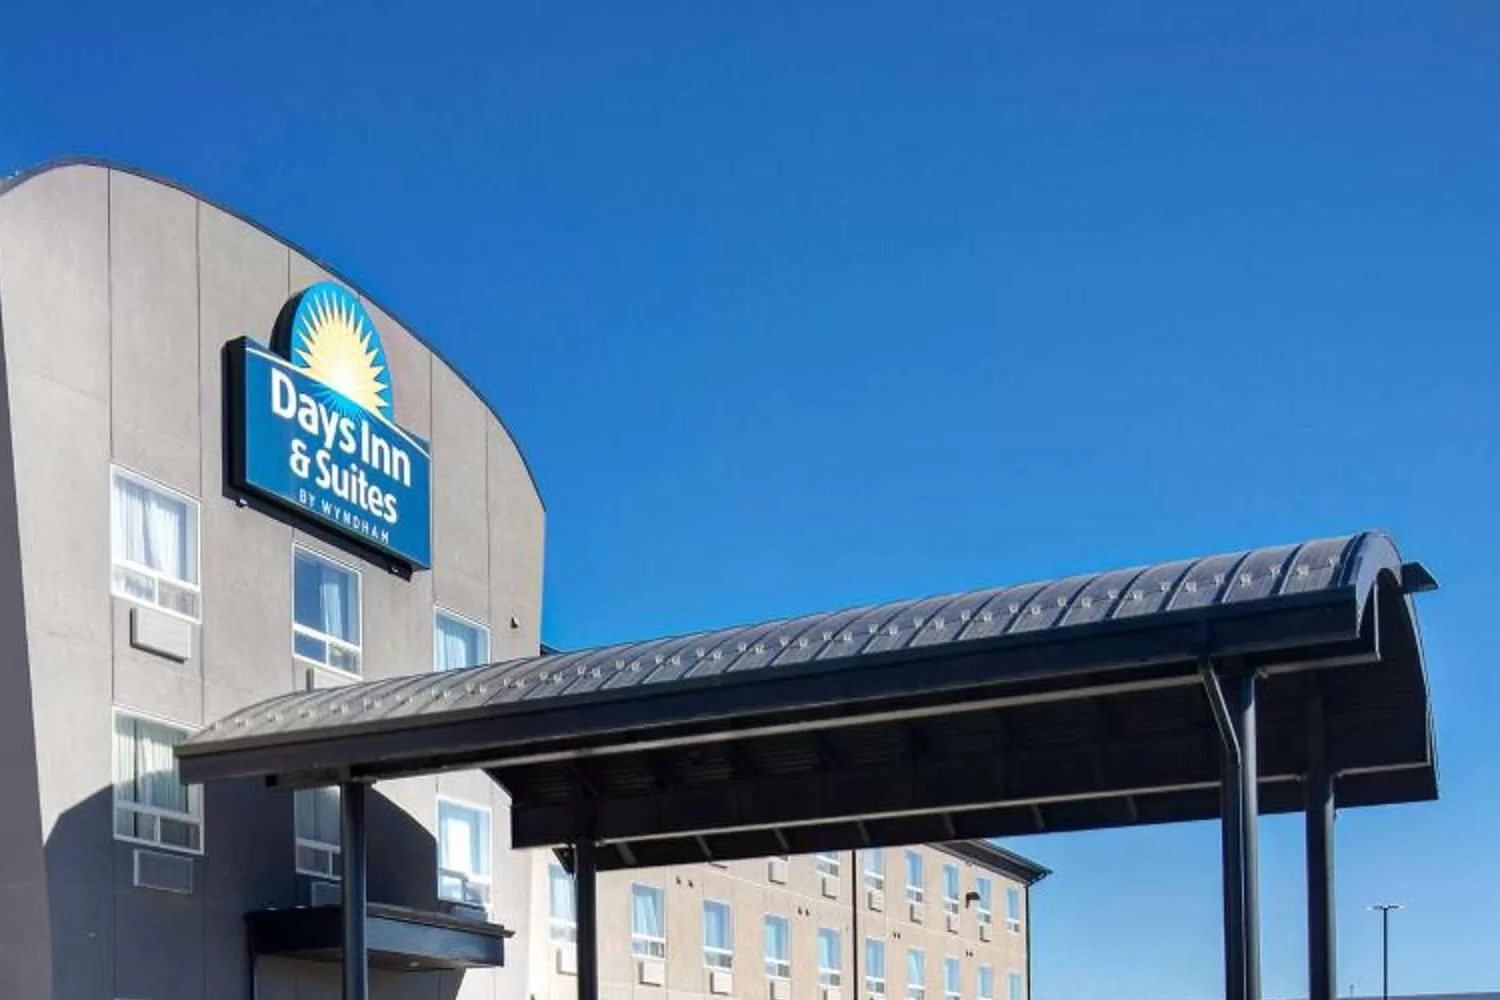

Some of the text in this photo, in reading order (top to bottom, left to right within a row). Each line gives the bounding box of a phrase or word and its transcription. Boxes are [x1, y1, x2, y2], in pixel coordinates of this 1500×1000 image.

[271, 367, 411, 487] Days Inn
[289, 439, 398, 524] & Suites
[299, 488, 316, 506] BY
